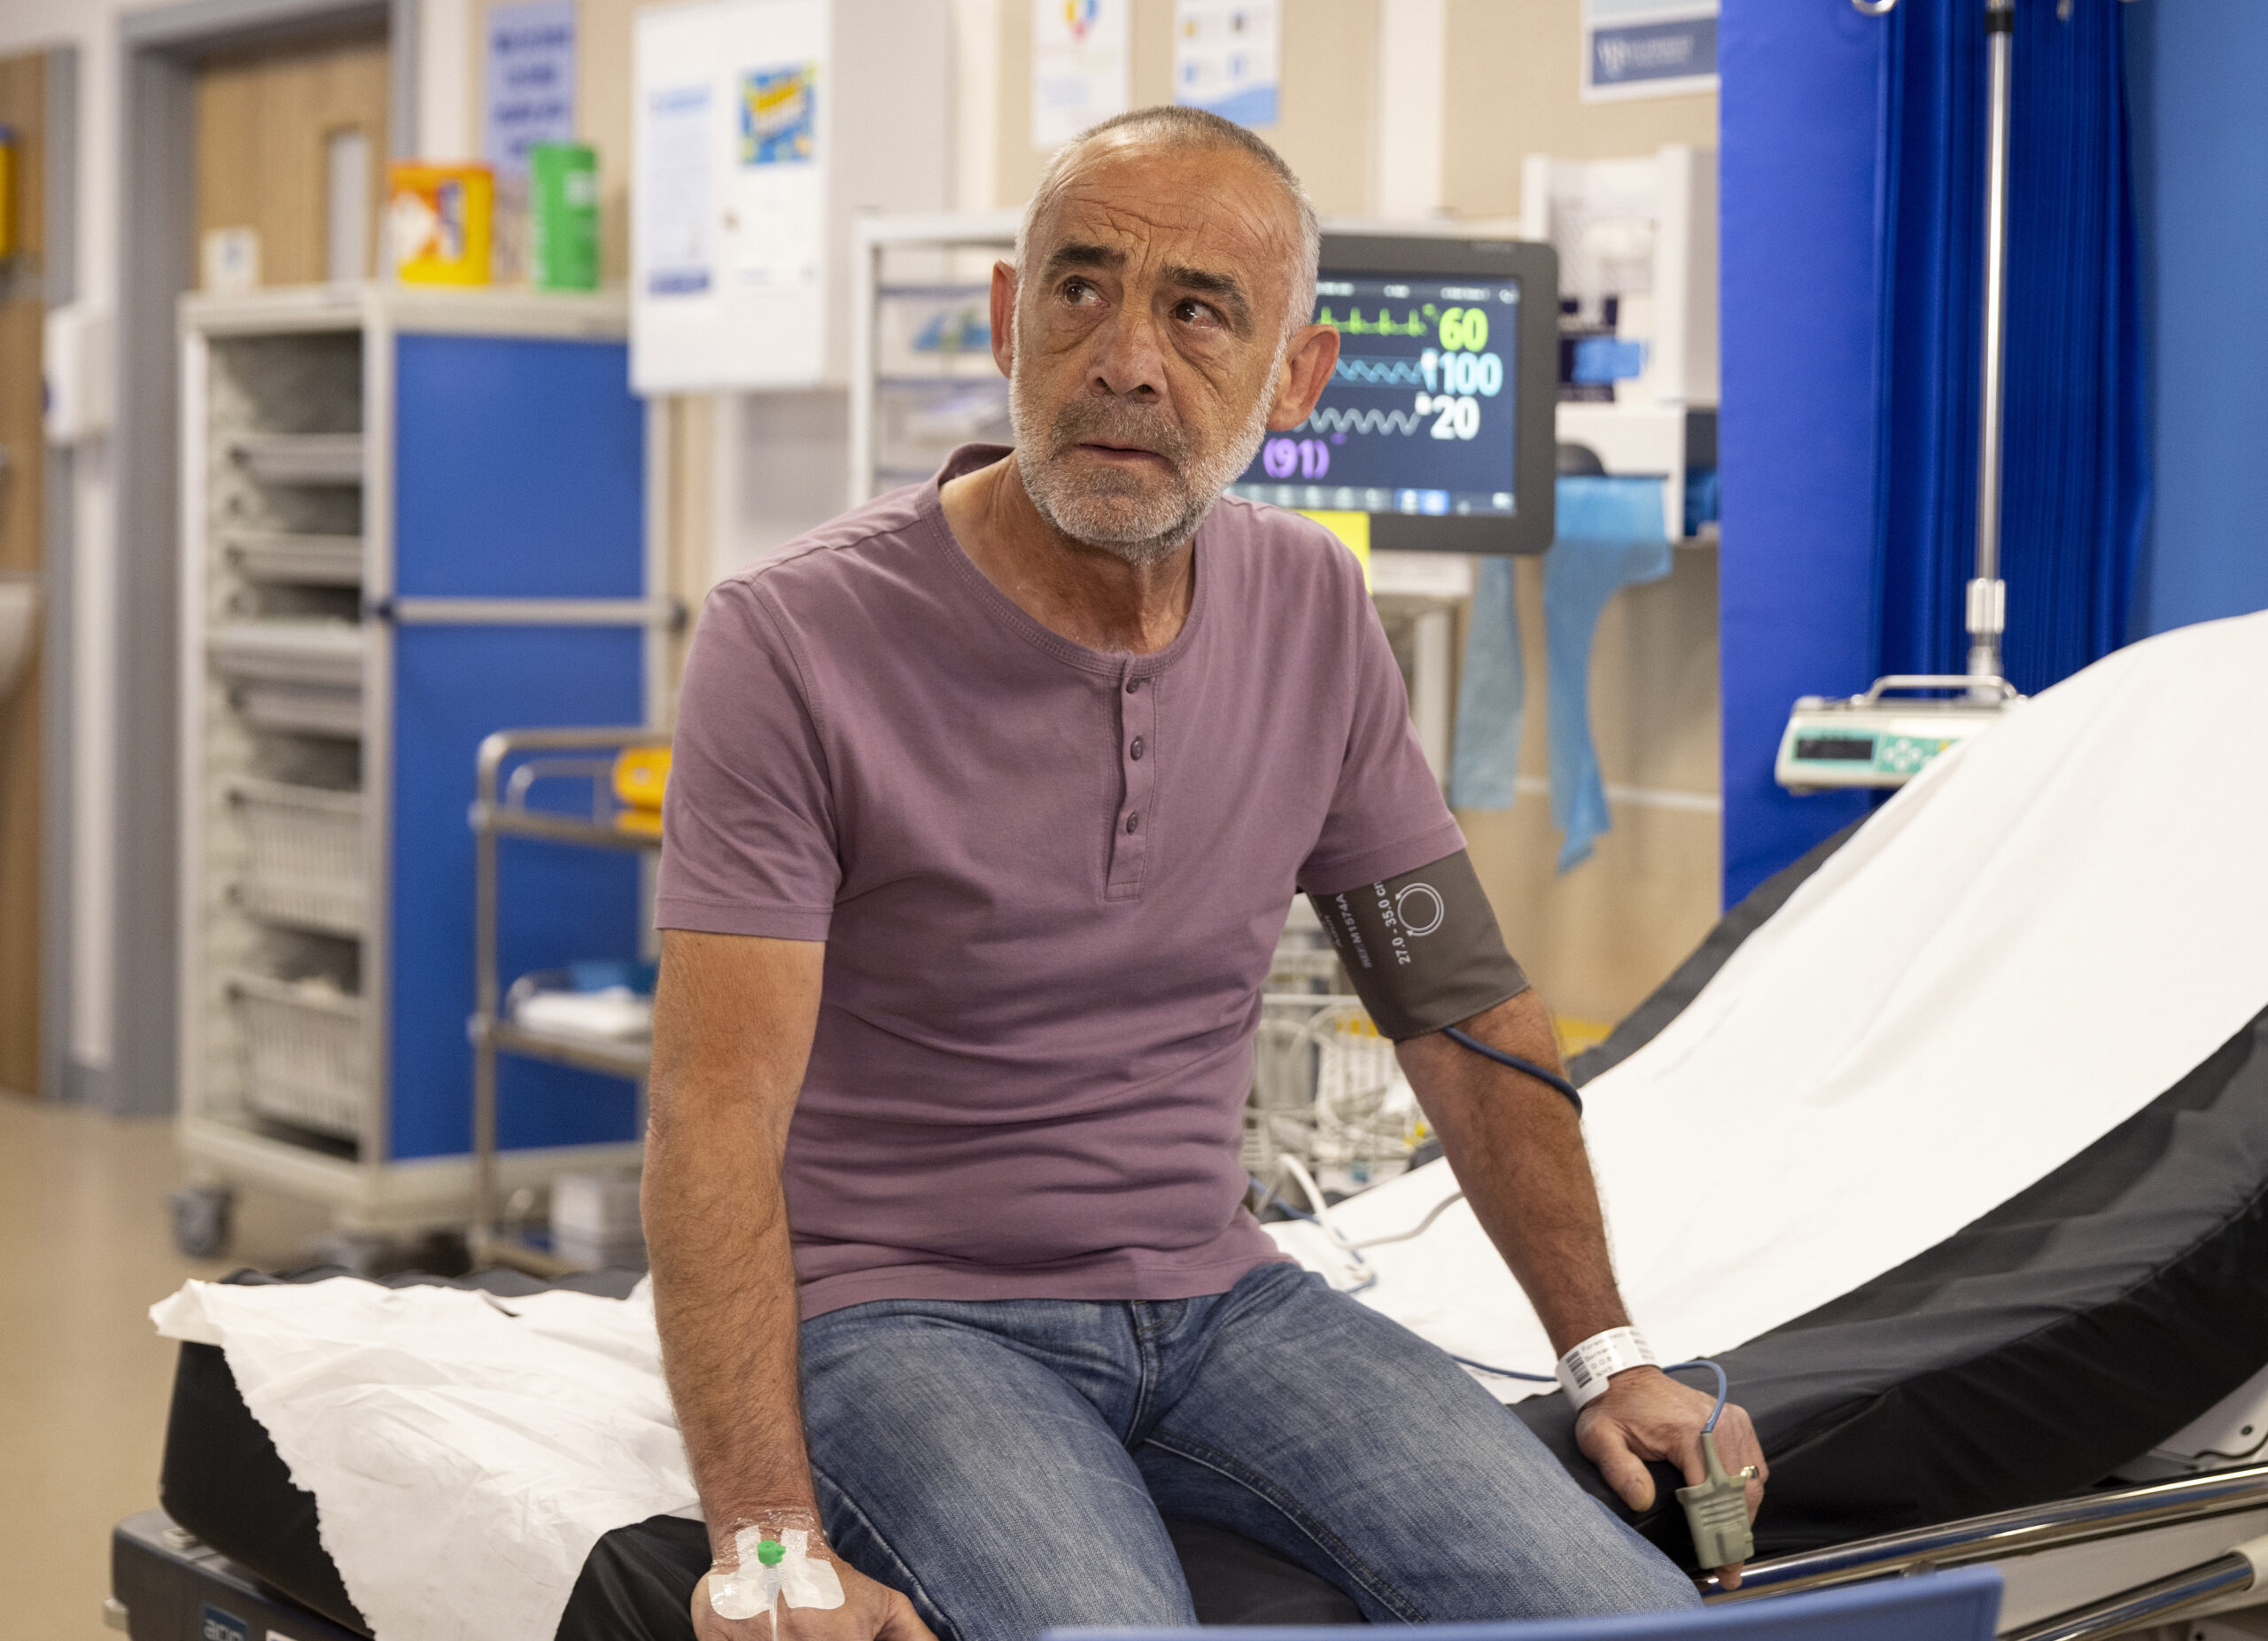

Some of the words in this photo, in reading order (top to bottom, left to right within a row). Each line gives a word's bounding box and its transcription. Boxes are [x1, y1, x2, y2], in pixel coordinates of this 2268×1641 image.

[1439, 307, 1488, 352] 60
[1439, 351, 1503, 397] 100
[1430, 394, 1480, 440] 20
[1262, 437, 1330, 479] (91)
[1335, 893, 1363, 945] M1574A
[1378, 898, 1397, 928] 35.0
[1391, 937, 1411, 965] 27.0
